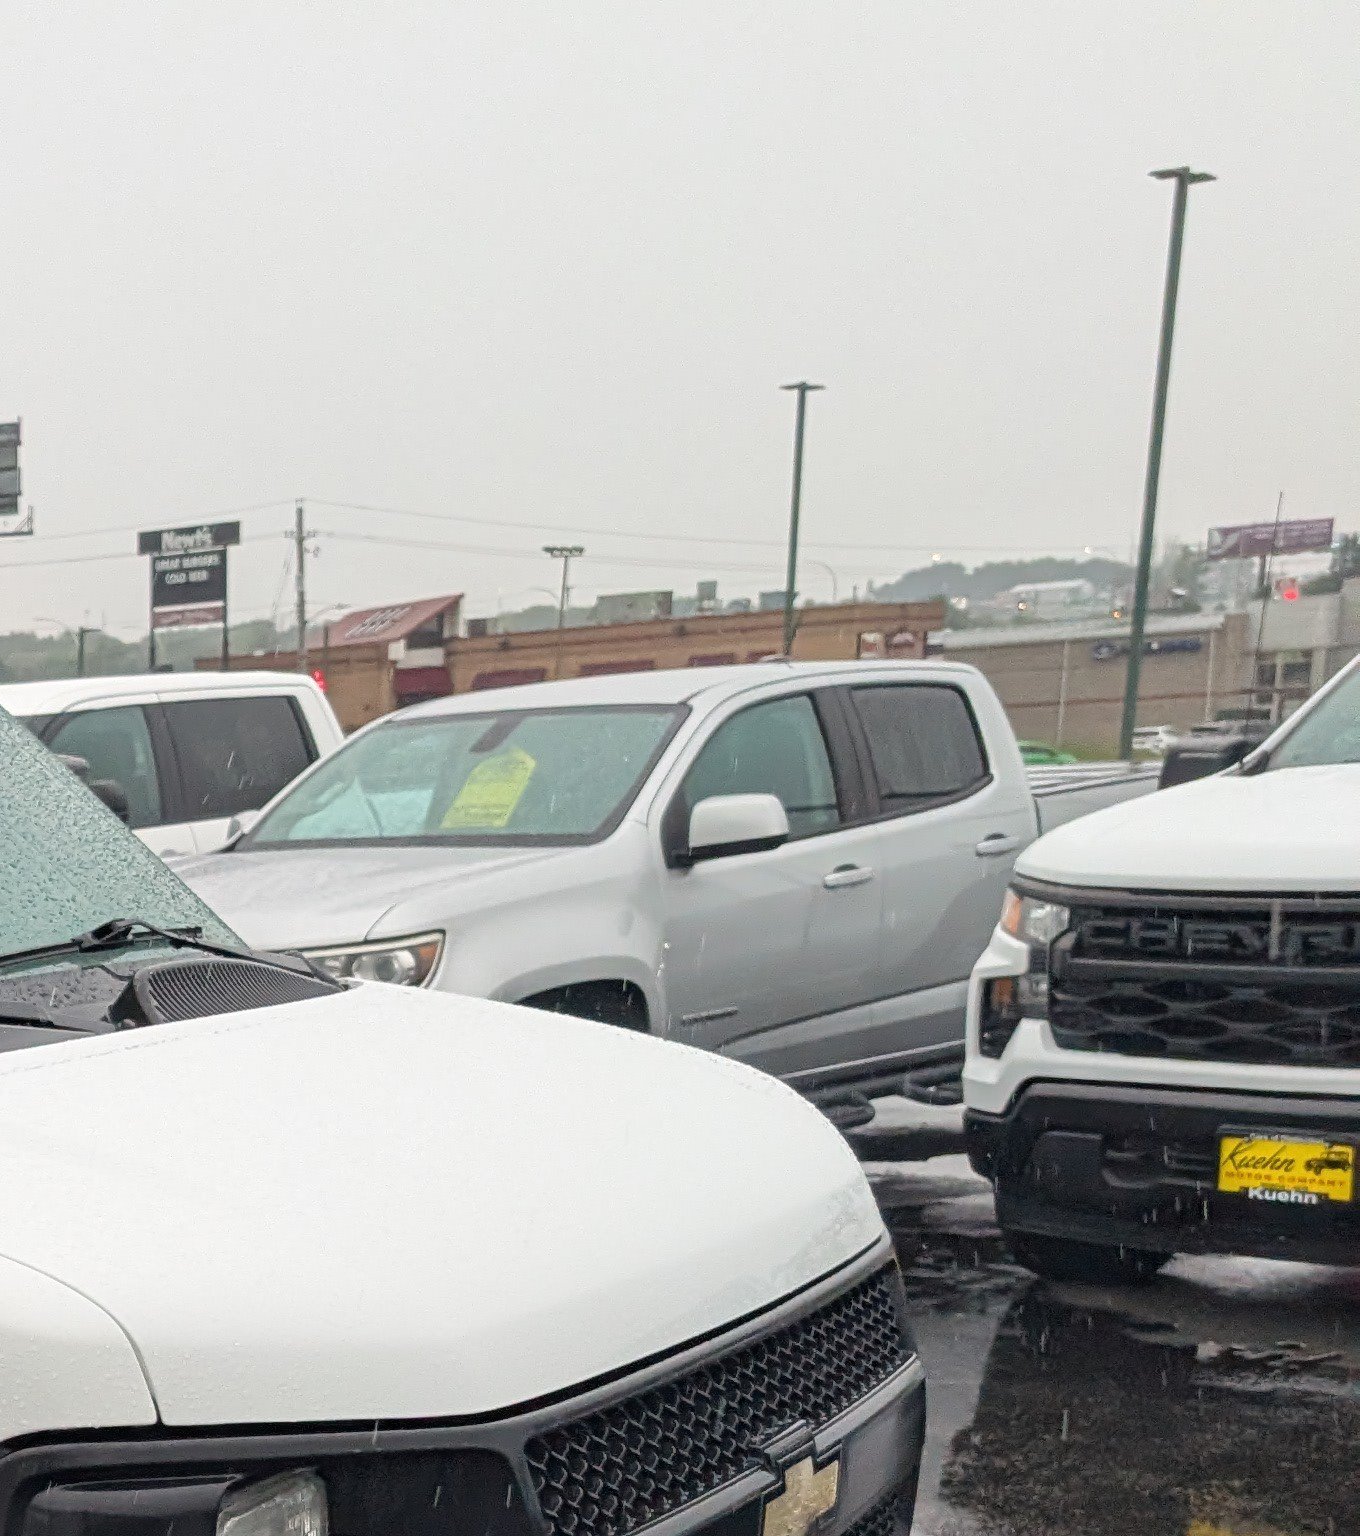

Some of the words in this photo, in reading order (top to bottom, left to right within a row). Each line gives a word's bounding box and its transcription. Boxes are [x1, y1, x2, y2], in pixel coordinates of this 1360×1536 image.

[1222, 1140, 1296, 1173] Kuehn
[1224, 1170, 1272, 1181] MOTOR
[1277, 1174, 1348, 1188] COMPANY
[1248, 1185, 1318, 1205] Kuehn
